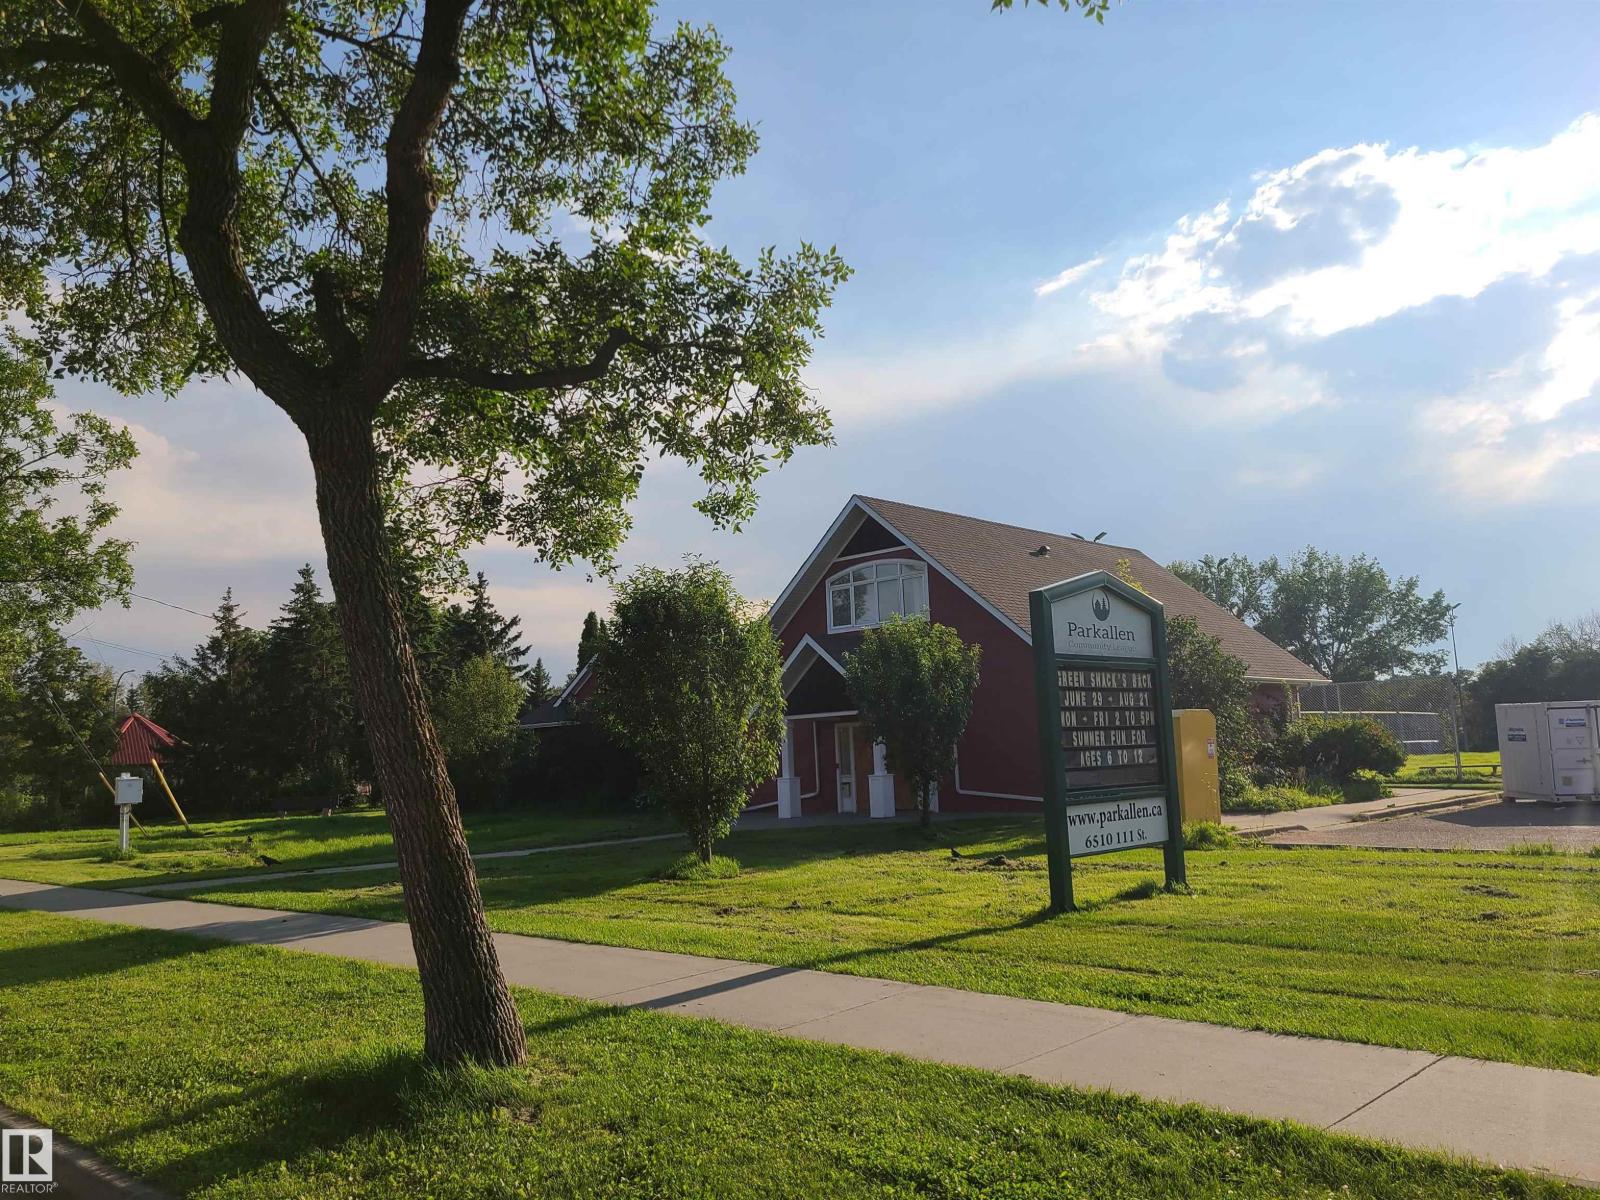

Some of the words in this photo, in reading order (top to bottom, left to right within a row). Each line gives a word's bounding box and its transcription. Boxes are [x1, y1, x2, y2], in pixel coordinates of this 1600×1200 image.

[1066, 622, 1135, 641] Parkallen
[1068, 640, 1111, 650] Community
[1132, 673, 1152, 688] BACK
[1064, 690, 1086, 706] JUNE
[1092, 691, 1103, 706] 29
[1119, 692, 1134, 707] AUG
[1139, 692, 1149, 706] 21
[1093, 711, 1109, 727] FRI
[1114, 711, 1121, 726] 2
[1125, 711, 1135, 726] TO
[1072, 730, 1105, 746] SUMMER
[1111, 730, 1126, 745] FUN
[1131, 730, 1147, 745] FOR
[1080, 751, 1101, 767] AGES
[1107, 751, 1112, 765] 6
[1118, 750, 1128, 765] TO
[1134, 749, 1143, 764] 12
[1067, 802, 1163, 828] www.parkallen.ca
[1085, 832, 1113, 849] 6510
[1116, 830, 1134, 844] 111
[1137, 828, 1148, 841] St.
